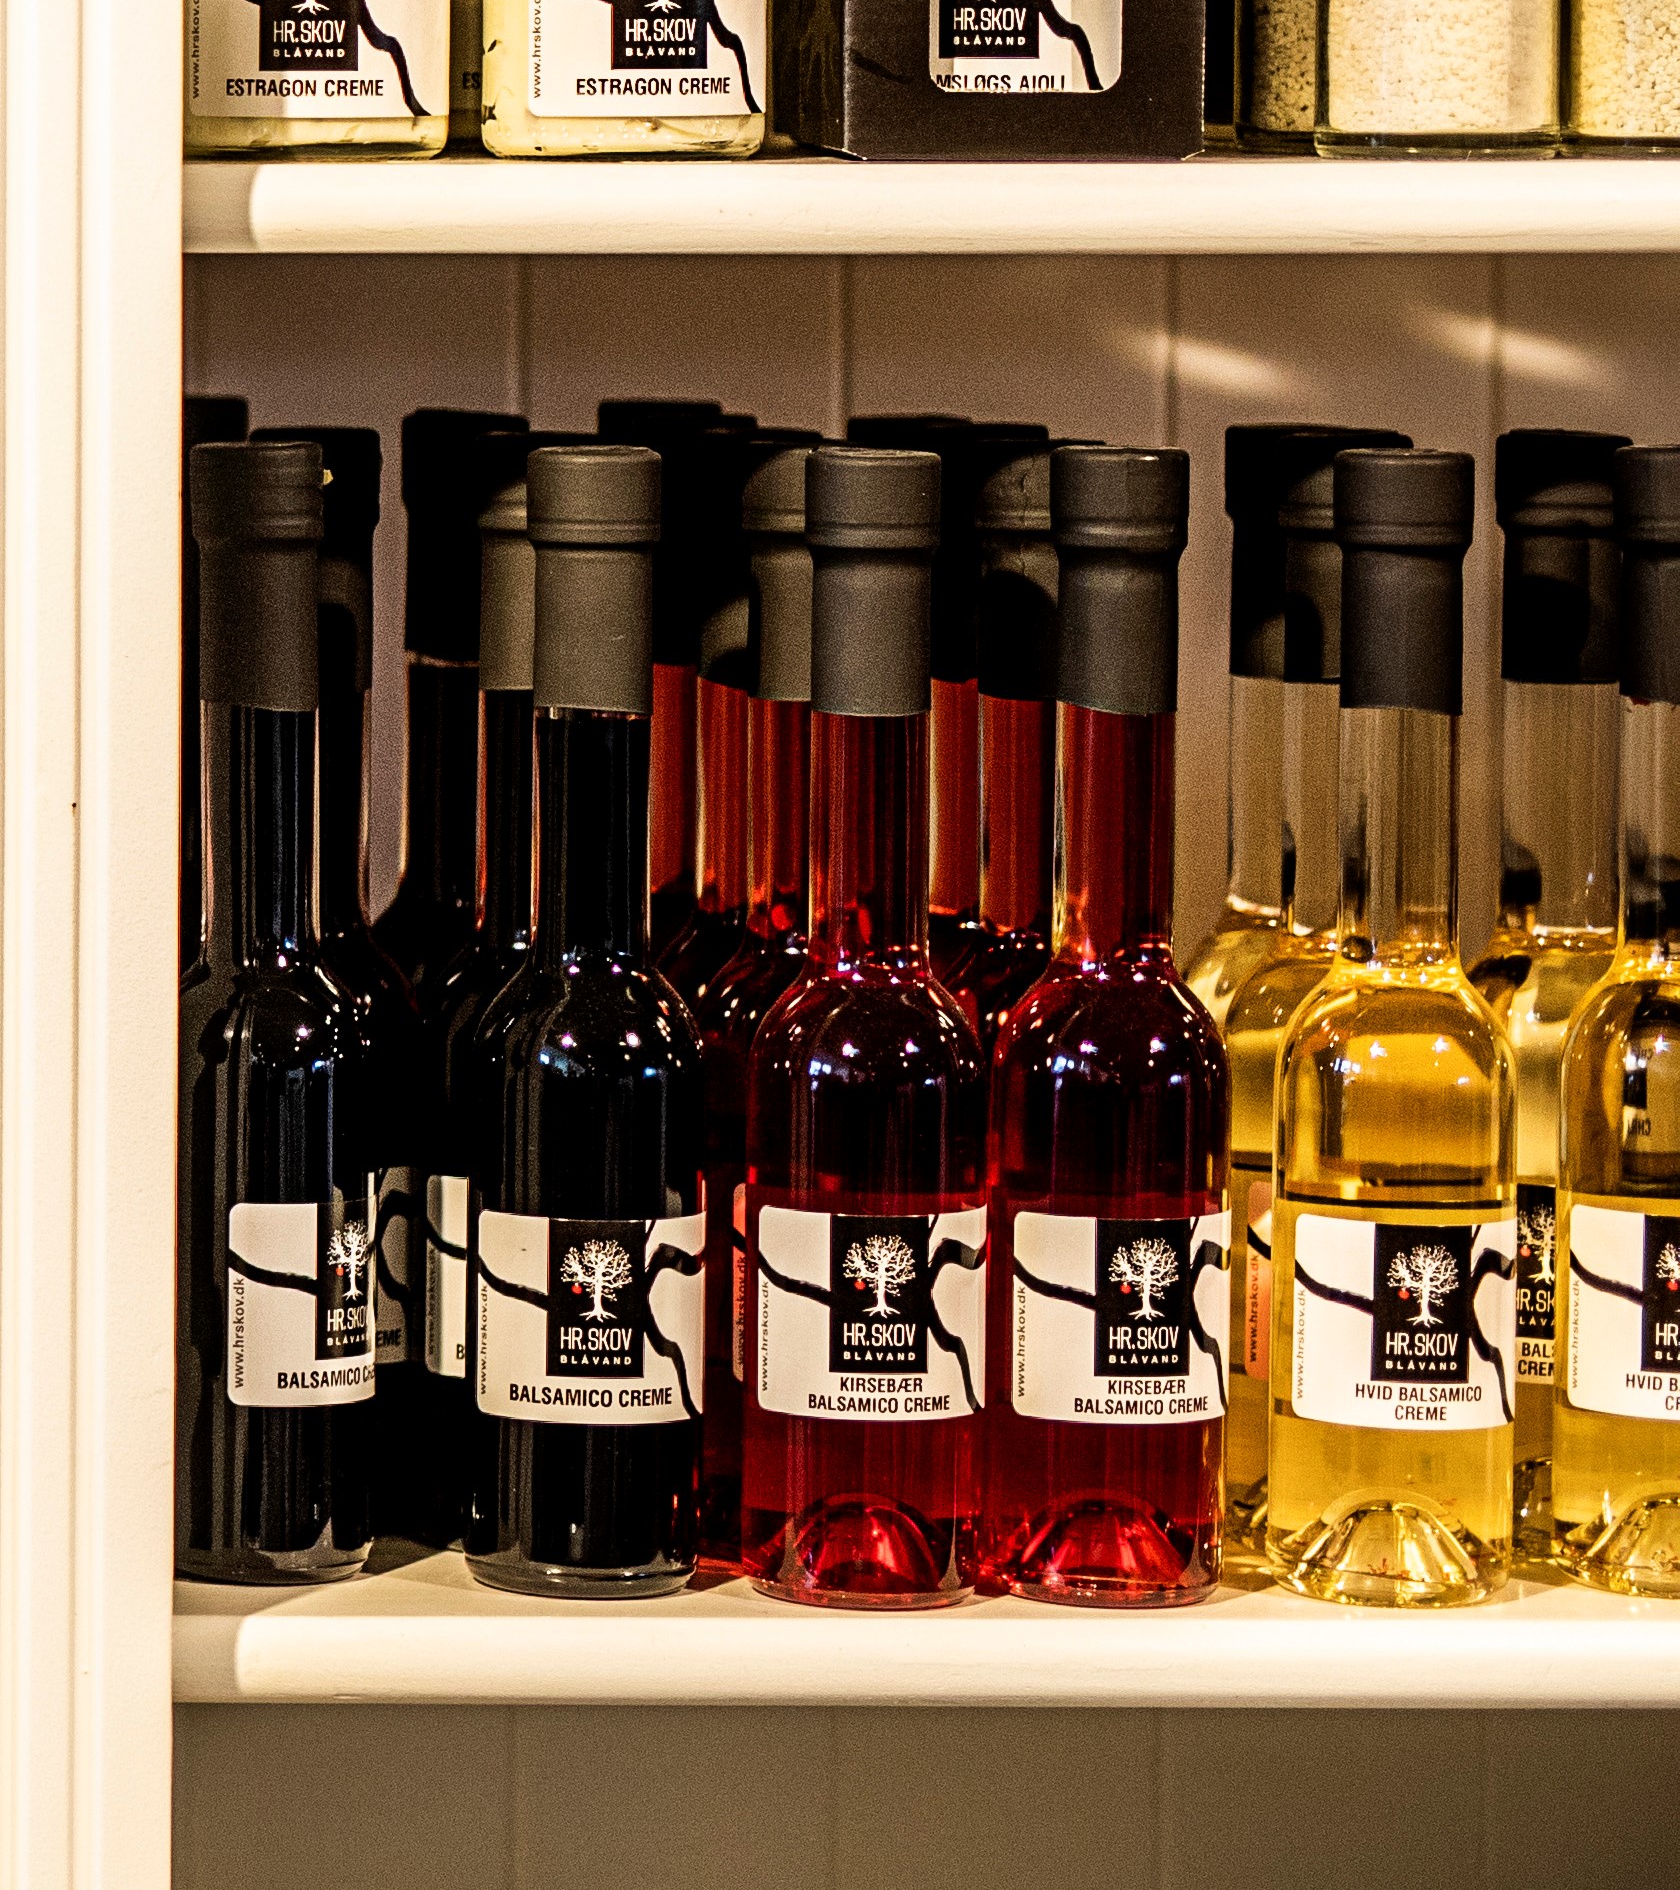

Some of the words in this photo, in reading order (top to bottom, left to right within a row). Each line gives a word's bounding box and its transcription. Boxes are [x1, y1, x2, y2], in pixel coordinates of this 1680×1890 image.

[576, 77, 672, 96] ESTRAGON
[678, 76, 731, 96] CREME
[1108, 1325, 1180, 1350] HR.SKOV
[509, 1383, 613, 1408] BALSAMICO
[618, 1386, 673, 1408] CREME
[1107, 1378, 1186, 1396] KIRSEBÆR
[1354, 1382, 1394, 1402] HVID
[1398, 1383, 1482, 1403] BALSAMICO
[1074, 1397, 1164, 1416] BALSAMICO
[1168, 1395, 1208, 1415] CREME
[1394, 1404, 1447, 1421] CREME
